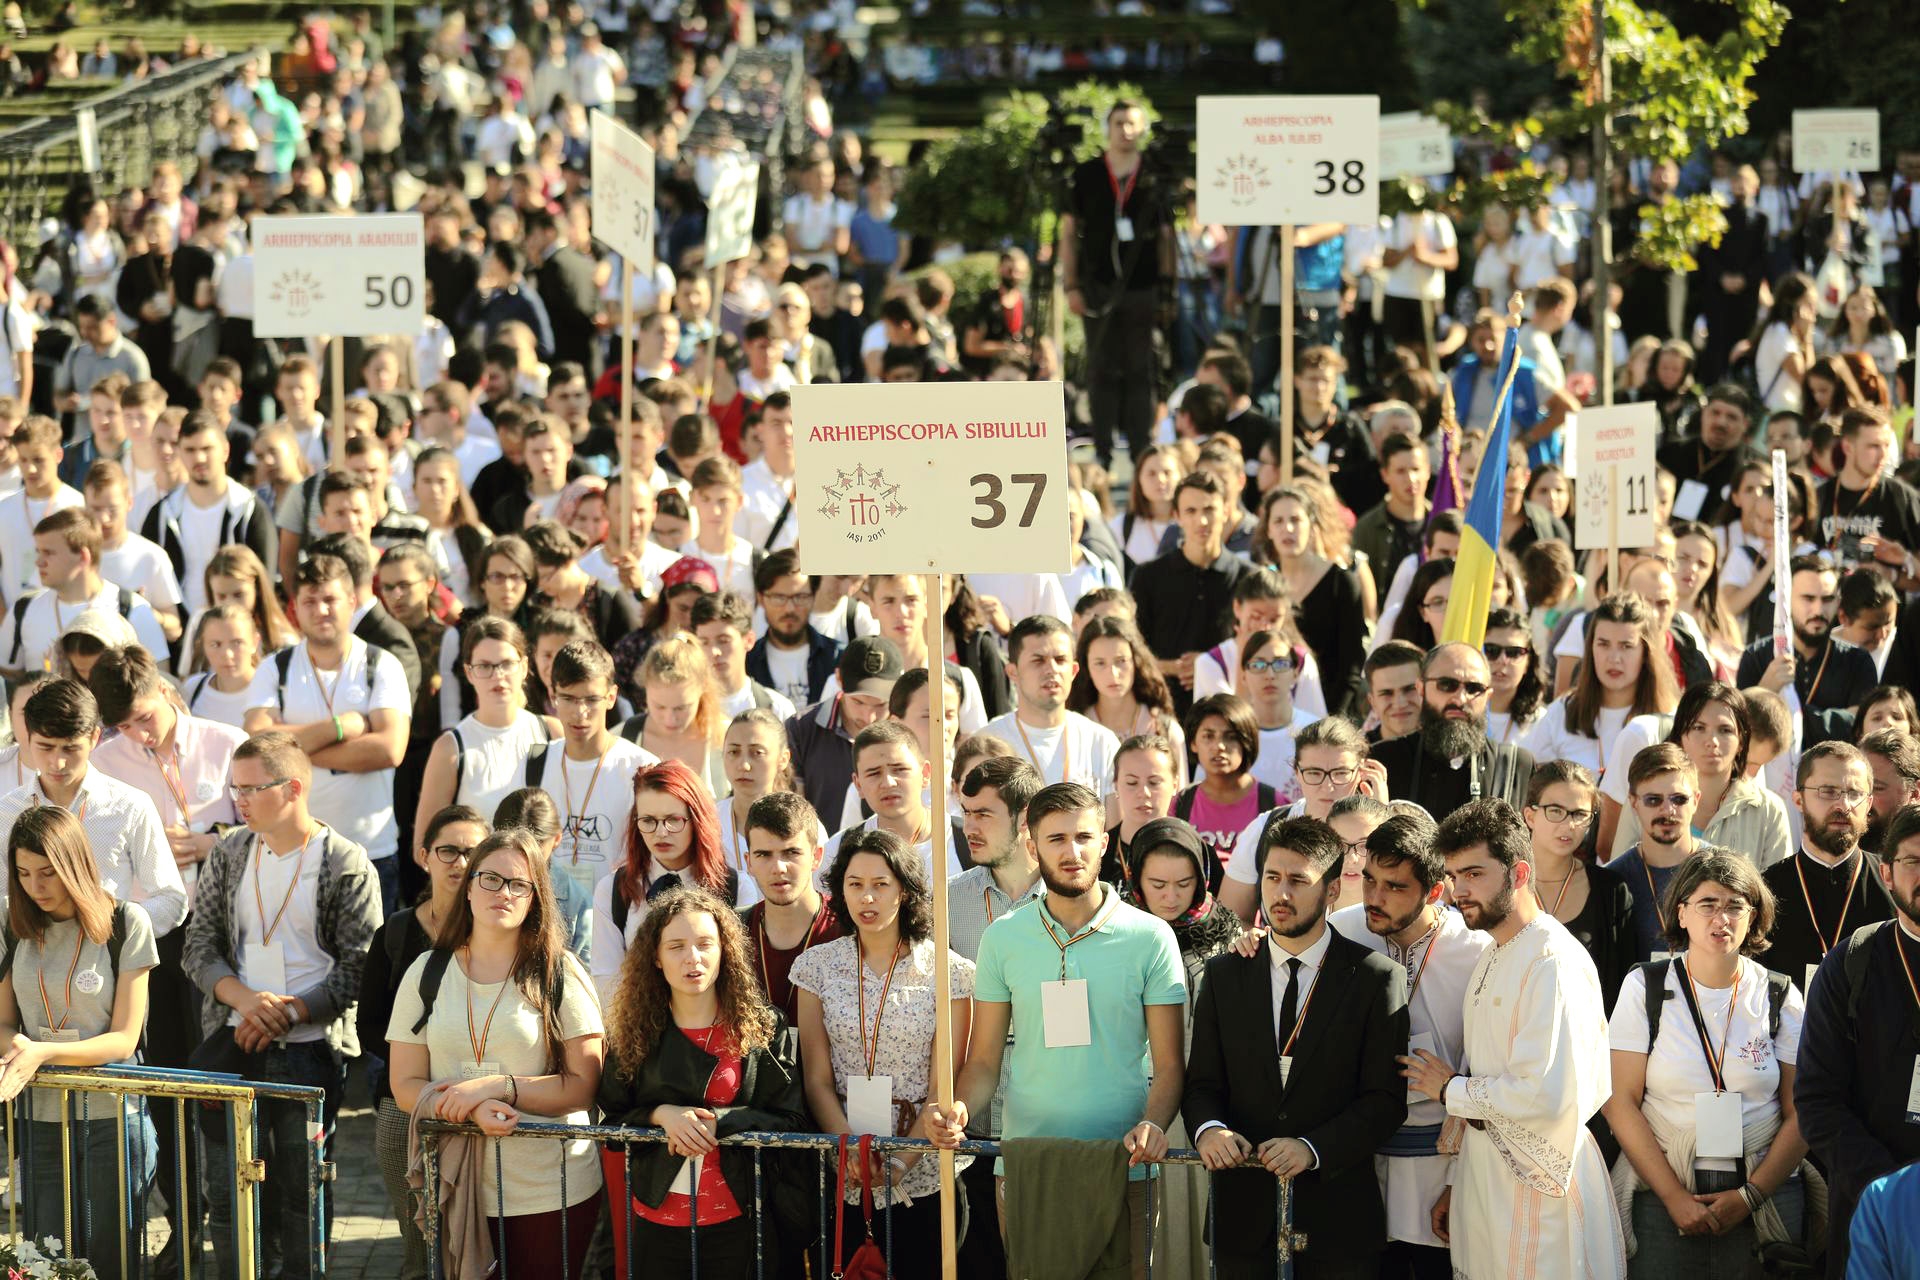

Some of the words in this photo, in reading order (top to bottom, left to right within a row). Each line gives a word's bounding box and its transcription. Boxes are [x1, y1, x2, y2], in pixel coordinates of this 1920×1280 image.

[1314, 160, 1365, 195] 38
[634, 200, 649, 242] 37
[263, 232, 352, 247] ARHIEPISCOPIA
[365, 275, 413, 310] 50
[809, 424, 958, 442] ARHIEPISCOPIA
[965, 421, 1047, 439] SIBIULUI
[969, 473, 1048, 529] 37
[1626, 474, 1648, 515] 11
[867, 527, 886, 542] 2017
